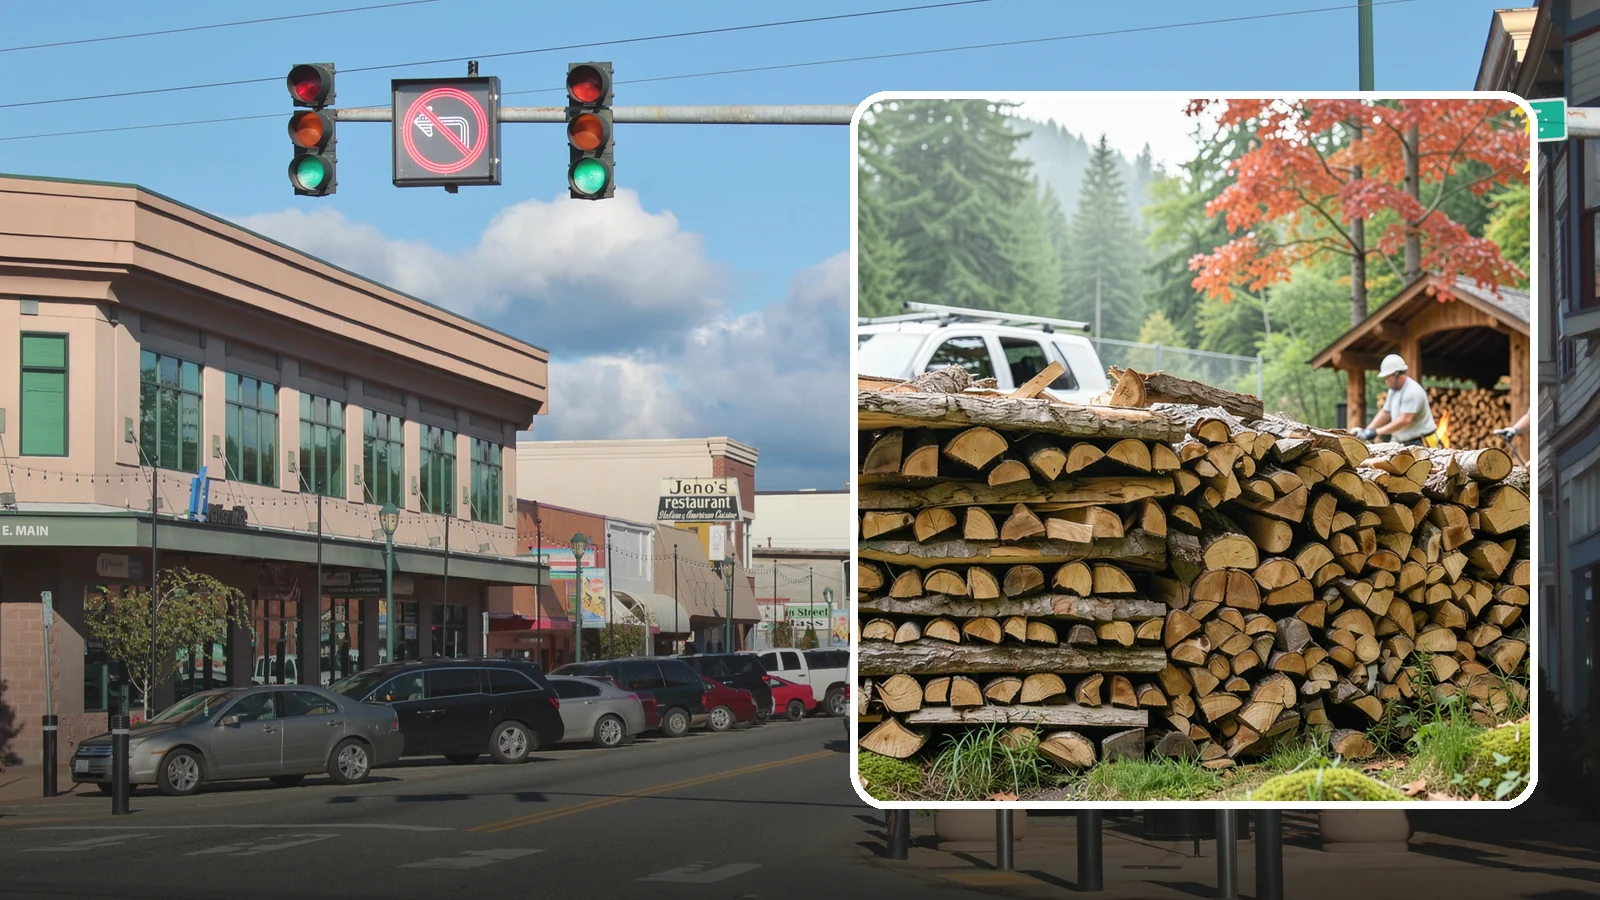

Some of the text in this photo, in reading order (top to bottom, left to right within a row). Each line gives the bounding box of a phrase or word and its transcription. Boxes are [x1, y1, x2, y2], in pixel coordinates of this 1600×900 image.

[669, 480, 727, 494] Jeno's
[665, 496, 731, 509] restaurant
[686, 509, 715, 519] American
[715, 509, 738, 519] Cuisine
[2, 525, 49, 536] E. MAIN
[797, 607, 828, 616] Street
